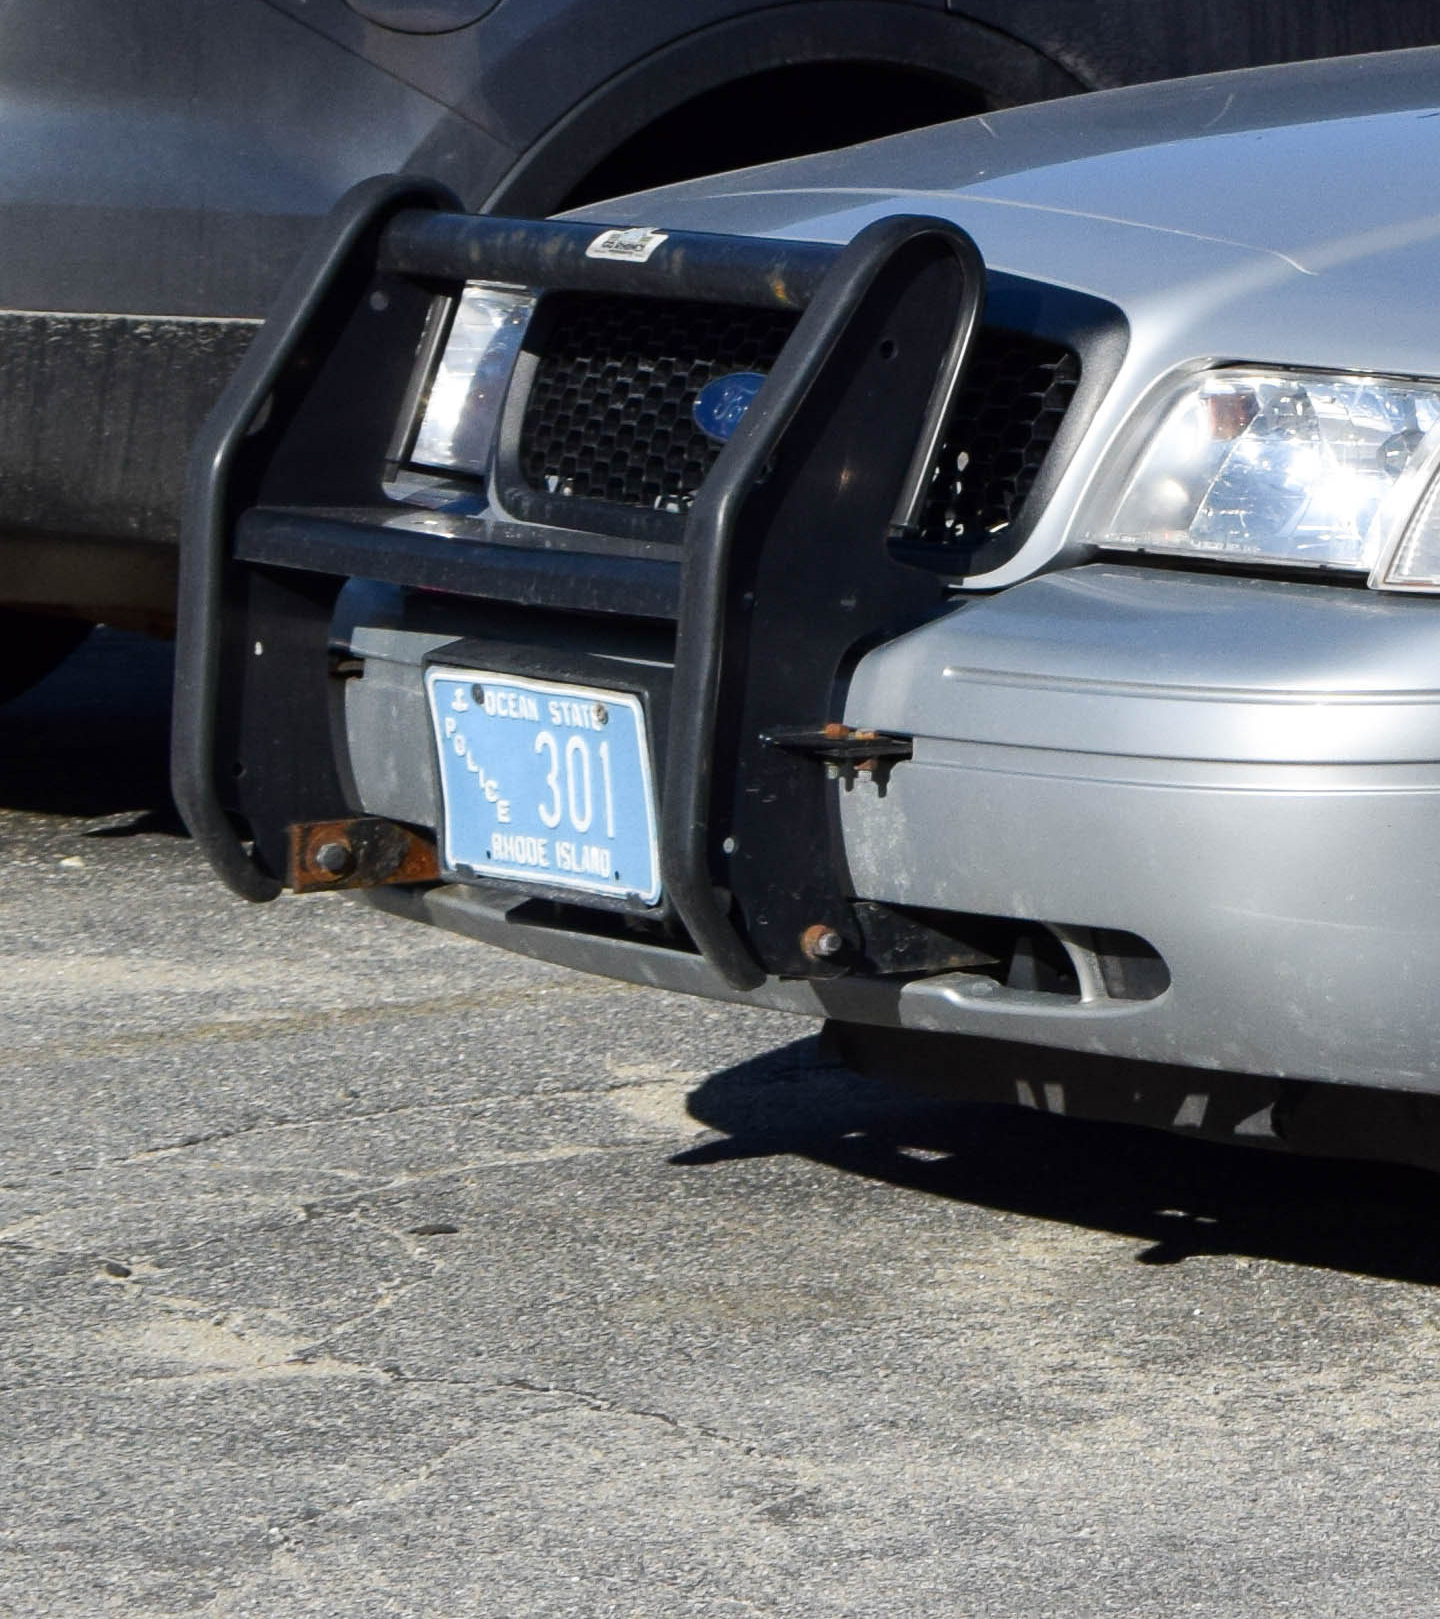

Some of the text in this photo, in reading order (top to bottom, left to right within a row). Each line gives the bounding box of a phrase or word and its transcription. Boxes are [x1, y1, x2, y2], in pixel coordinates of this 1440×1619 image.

[484, 690, 539, 722] OCEAN
[444, 716, 511, 824] POLICE
[534, 730, 615, 839] 301
[490, 833, 611, 878] RHODE ISLAND
